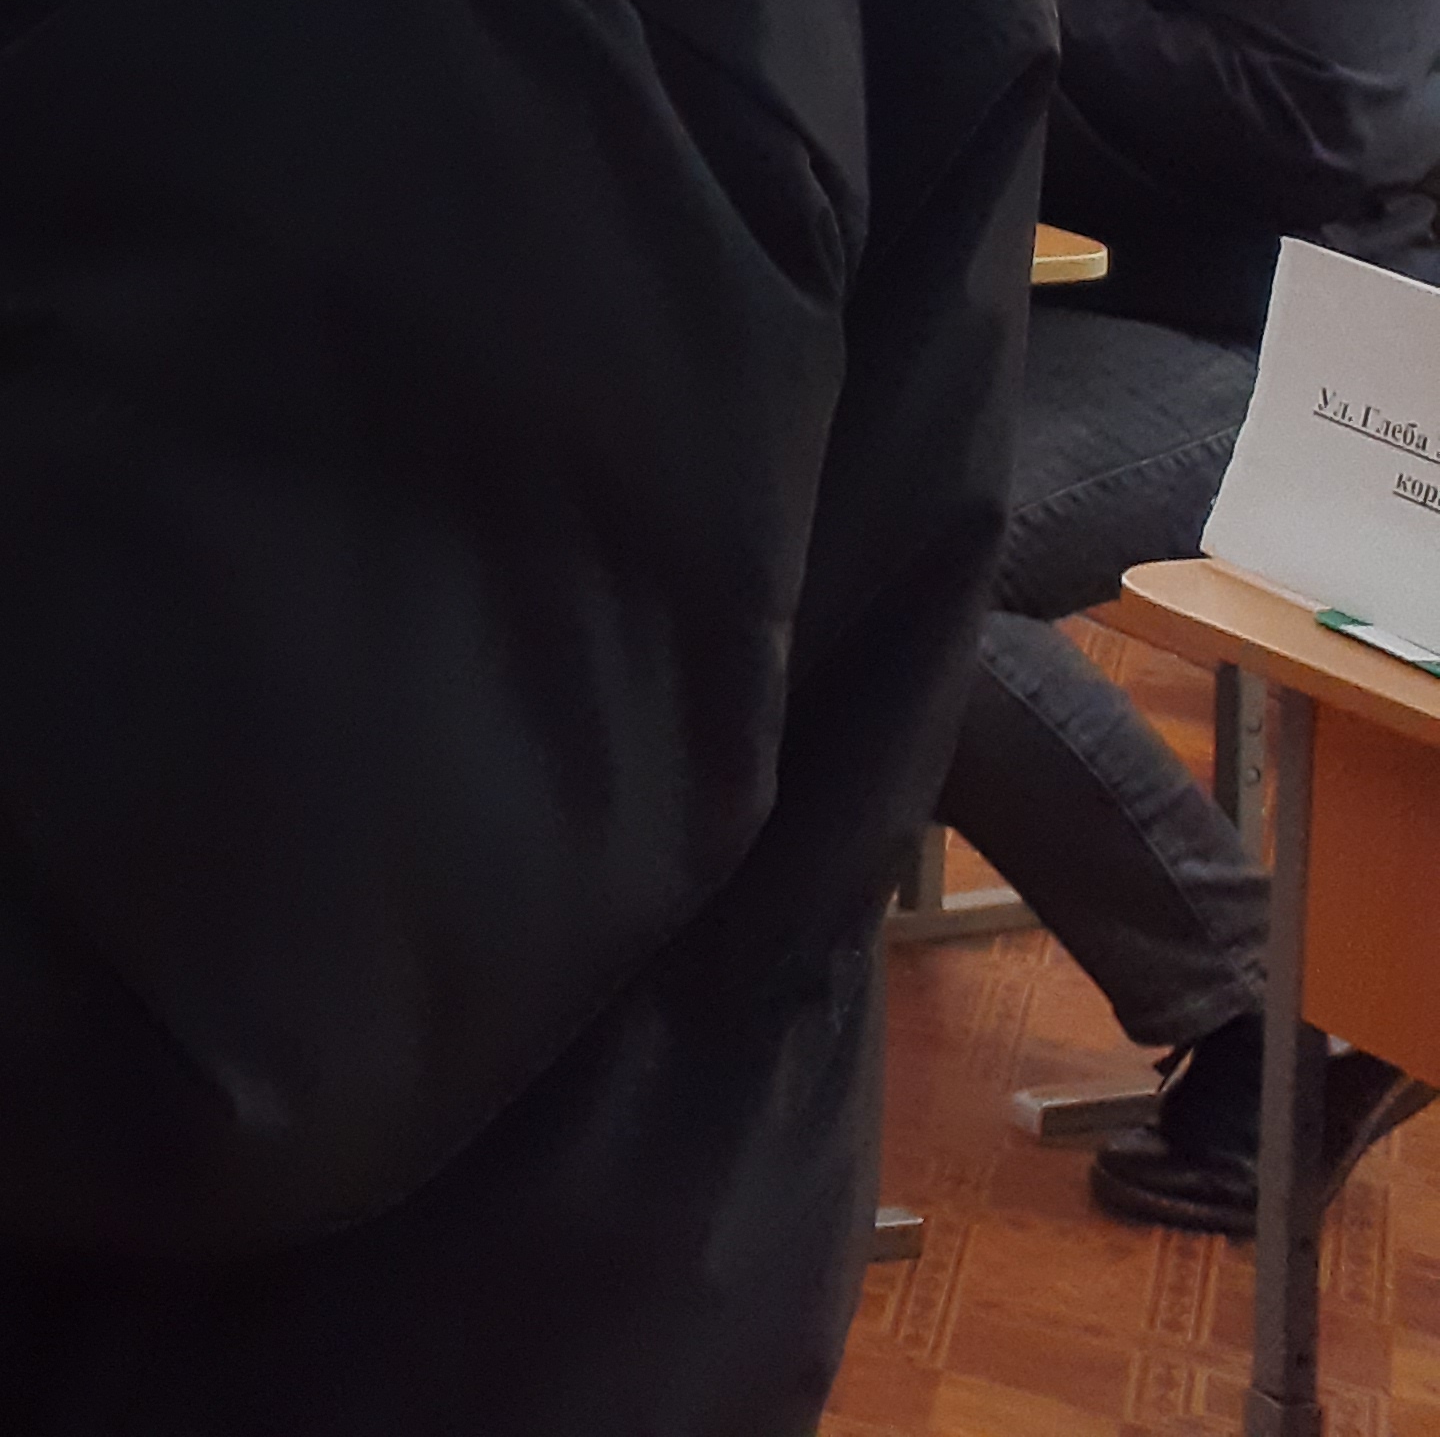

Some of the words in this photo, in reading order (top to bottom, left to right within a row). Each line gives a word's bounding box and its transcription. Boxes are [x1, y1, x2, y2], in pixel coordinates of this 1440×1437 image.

[1317, 387, 1354, 422] Ул.
[1360, 405, 1428, 451] Глеба
[1396, 472, 1440, 506] кор
